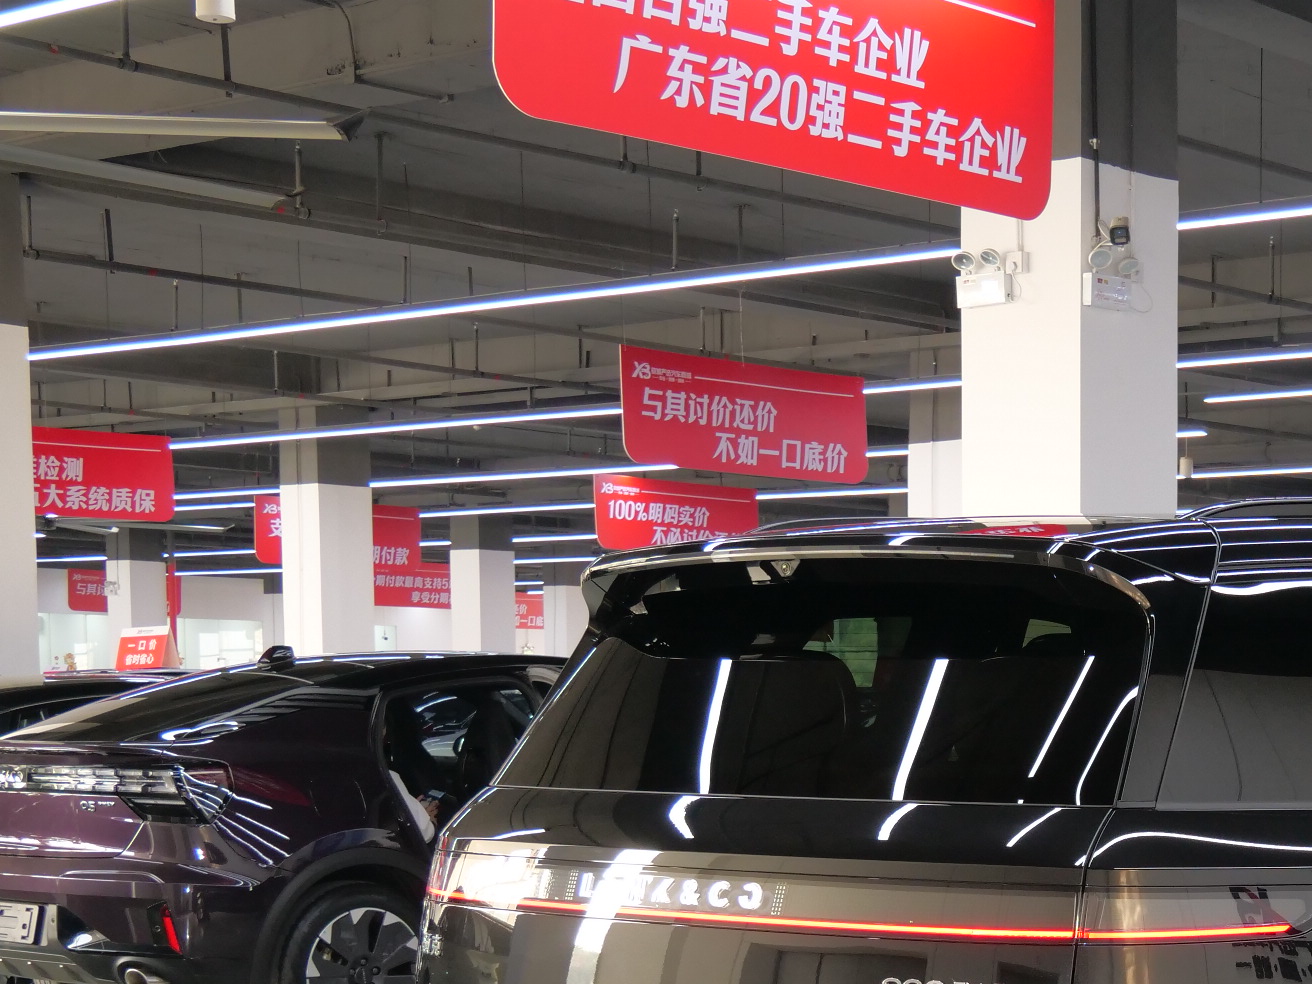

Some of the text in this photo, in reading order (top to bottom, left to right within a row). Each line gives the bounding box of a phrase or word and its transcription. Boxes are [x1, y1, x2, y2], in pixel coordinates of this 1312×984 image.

[613, 34, 1027, 184] 广东省20强二手车企业
[641, 387, 778, 432] 与其讨价还价
[712, 432, 848, 474] 不如一口底价
[608, 499, 711, 528] 100%明码实价
